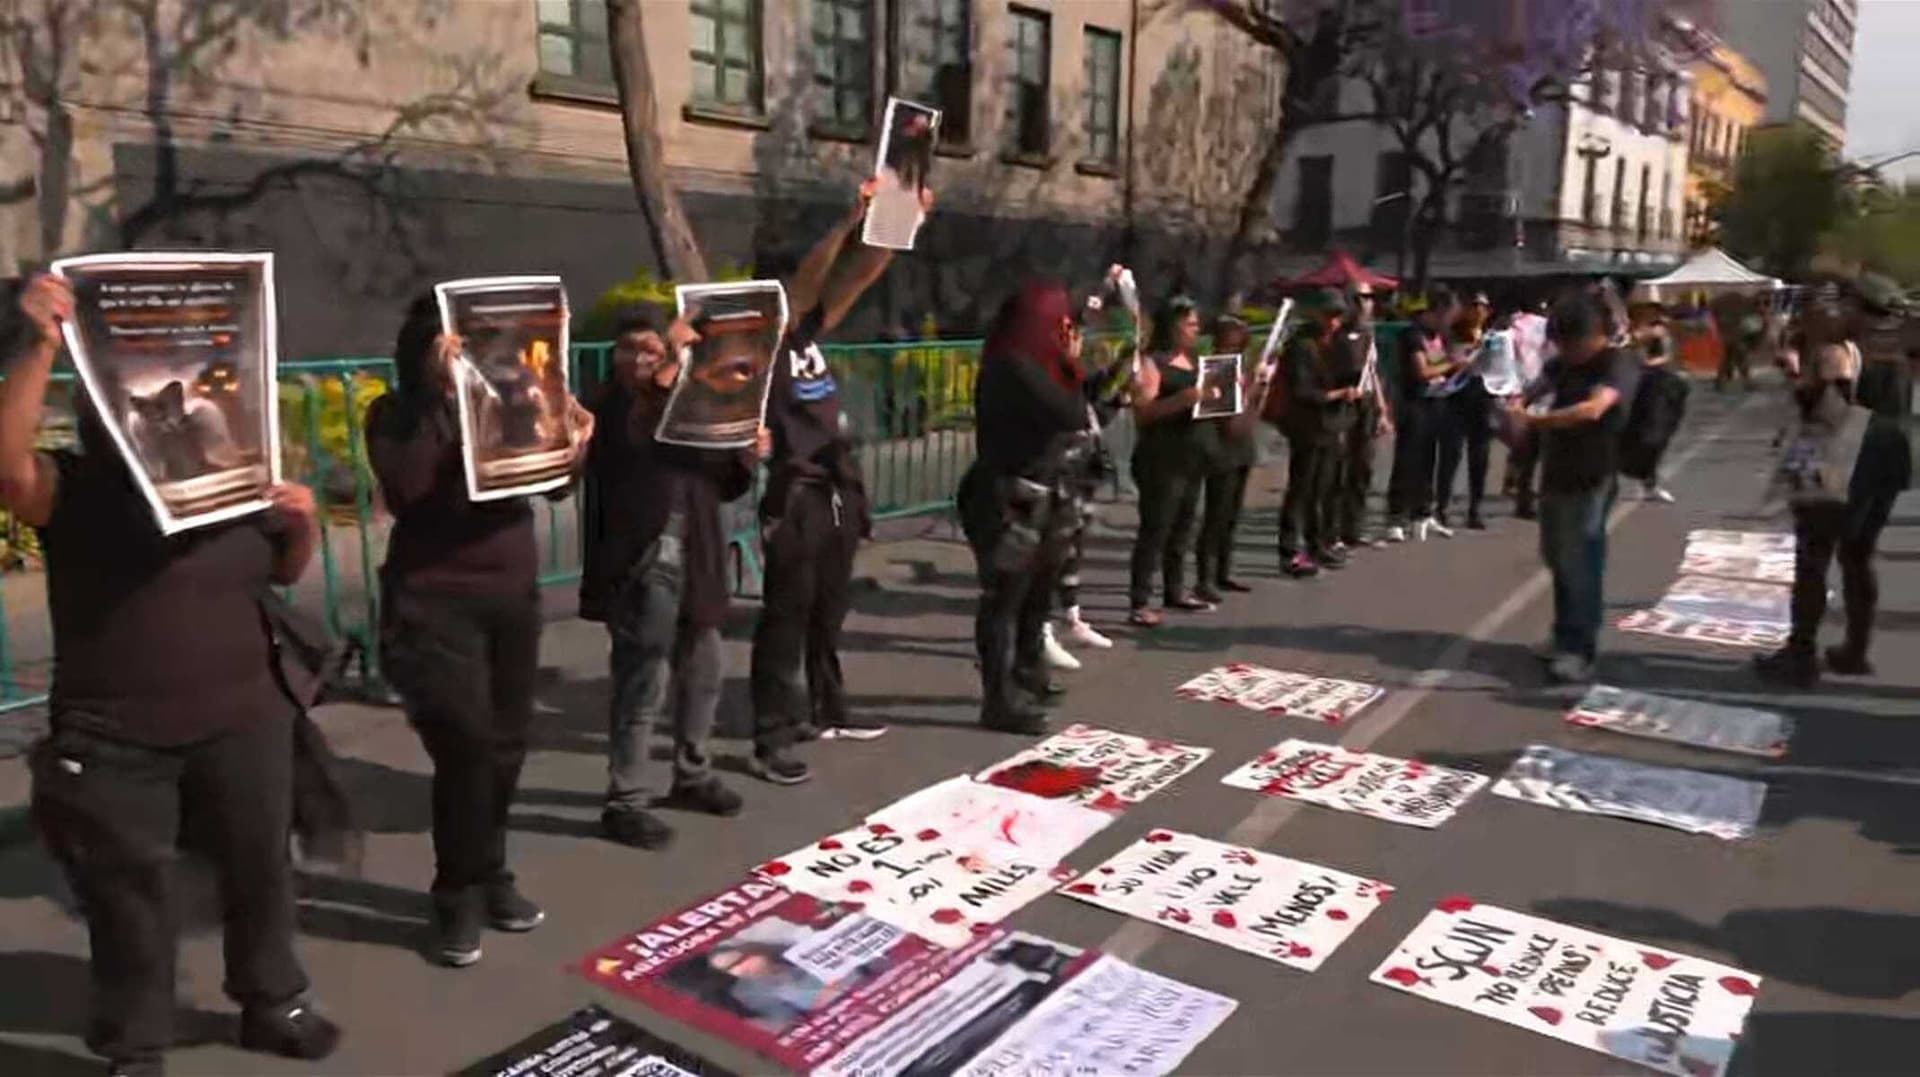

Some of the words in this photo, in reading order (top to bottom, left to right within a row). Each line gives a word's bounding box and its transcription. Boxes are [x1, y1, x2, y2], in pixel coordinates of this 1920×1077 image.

[806, 852, 862, 879] NO
[857, 835, 904, 855] ES
[872, 859, 922, 879] 1
[1102, 877, 1143, 896] SU
[1138, 849, 1190, 876] VIDA
[959, 863, 1037, 907] MILES
[1574, 960, 1639, 1026] REDUCE
